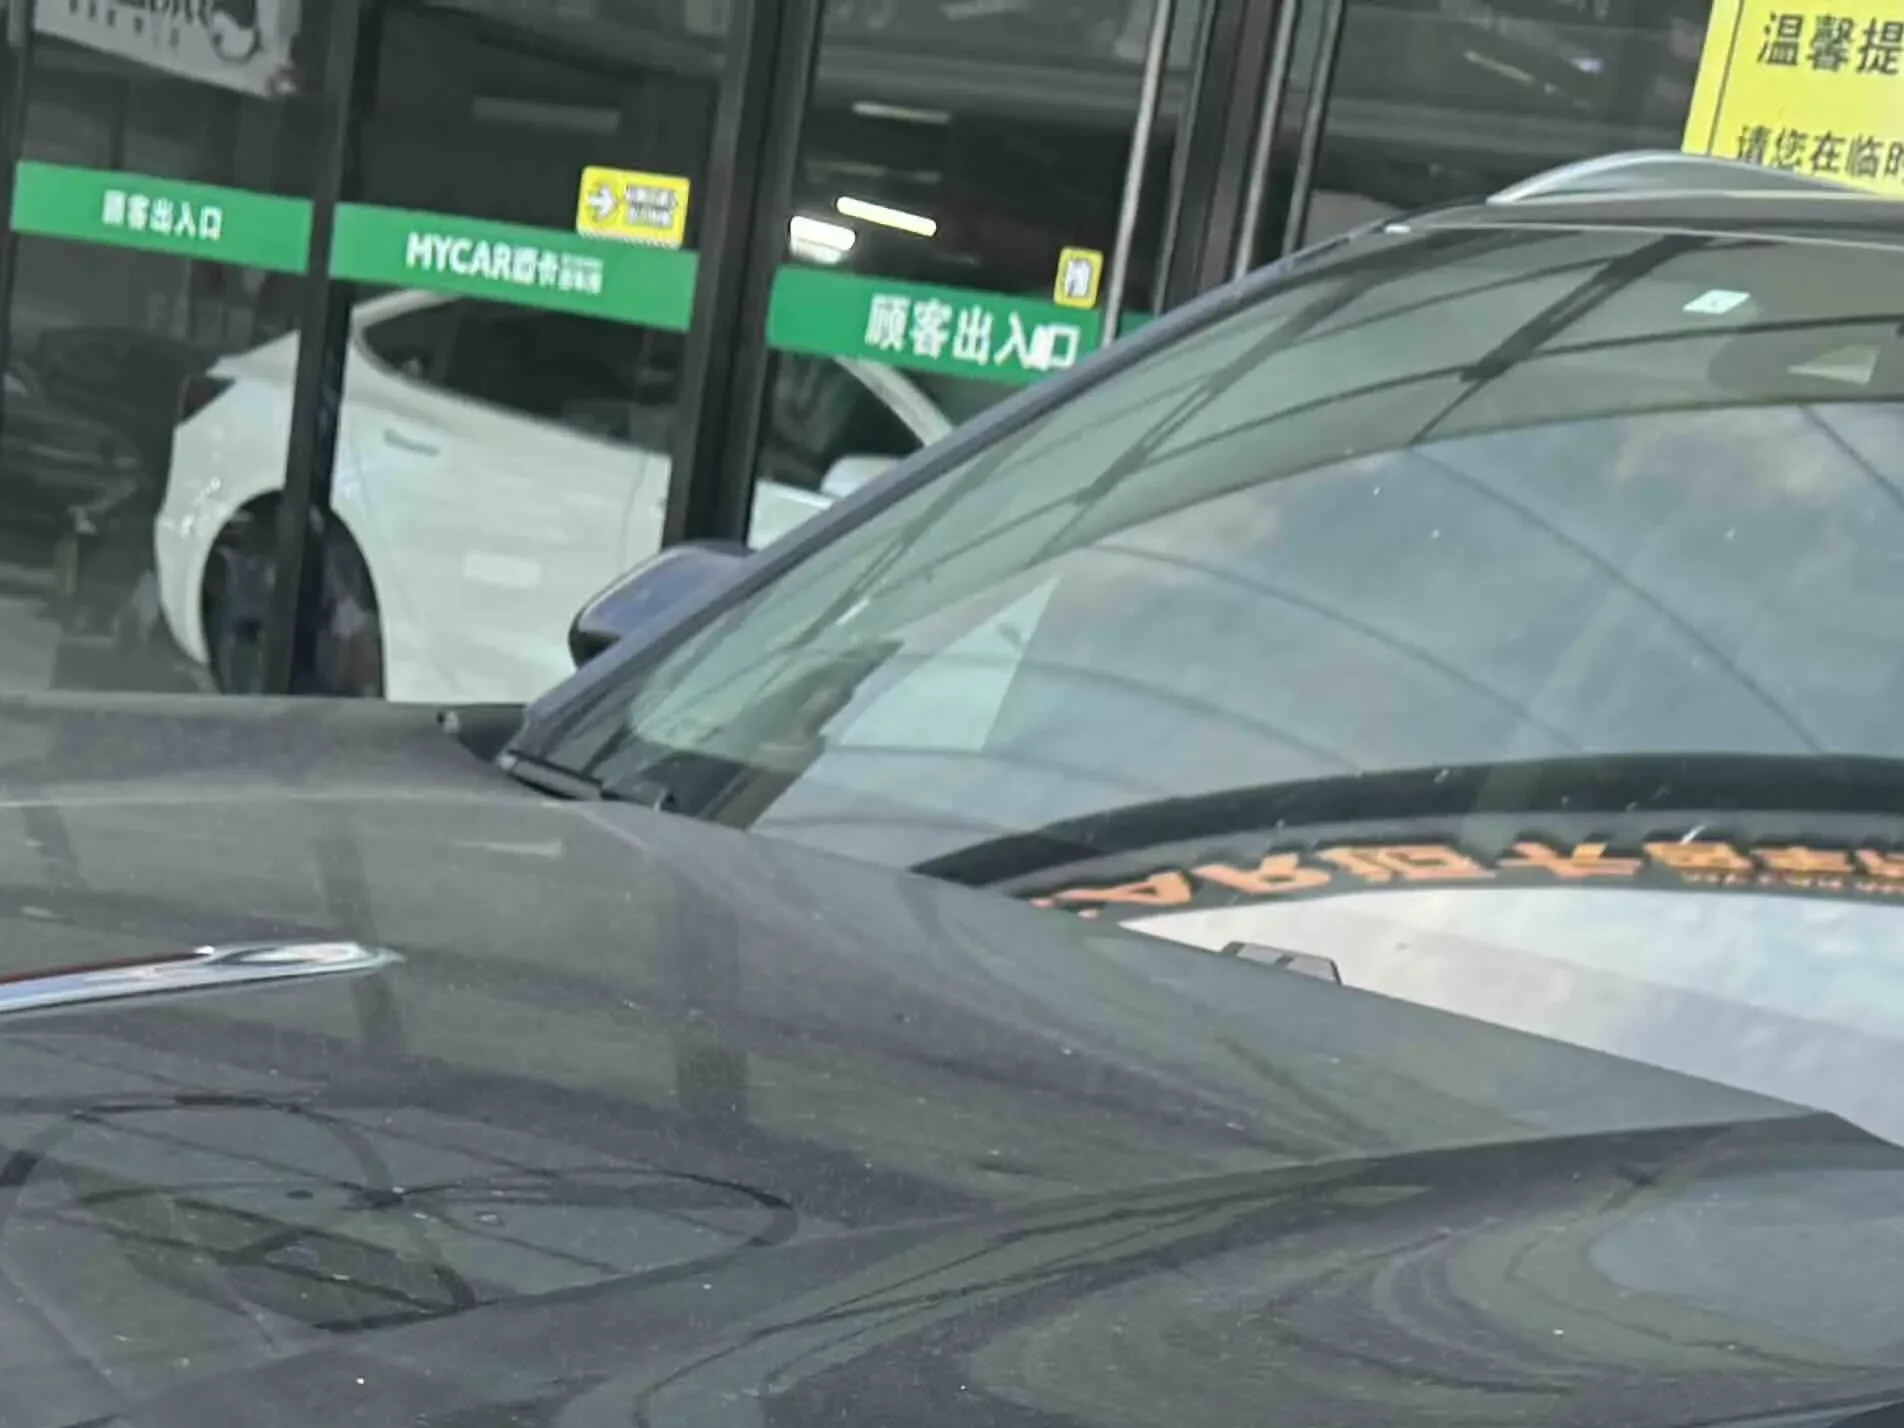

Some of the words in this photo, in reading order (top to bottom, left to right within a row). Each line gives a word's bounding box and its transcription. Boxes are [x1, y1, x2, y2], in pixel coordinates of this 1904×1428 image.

[864, 294, 1081, 371] 顾客出入口
